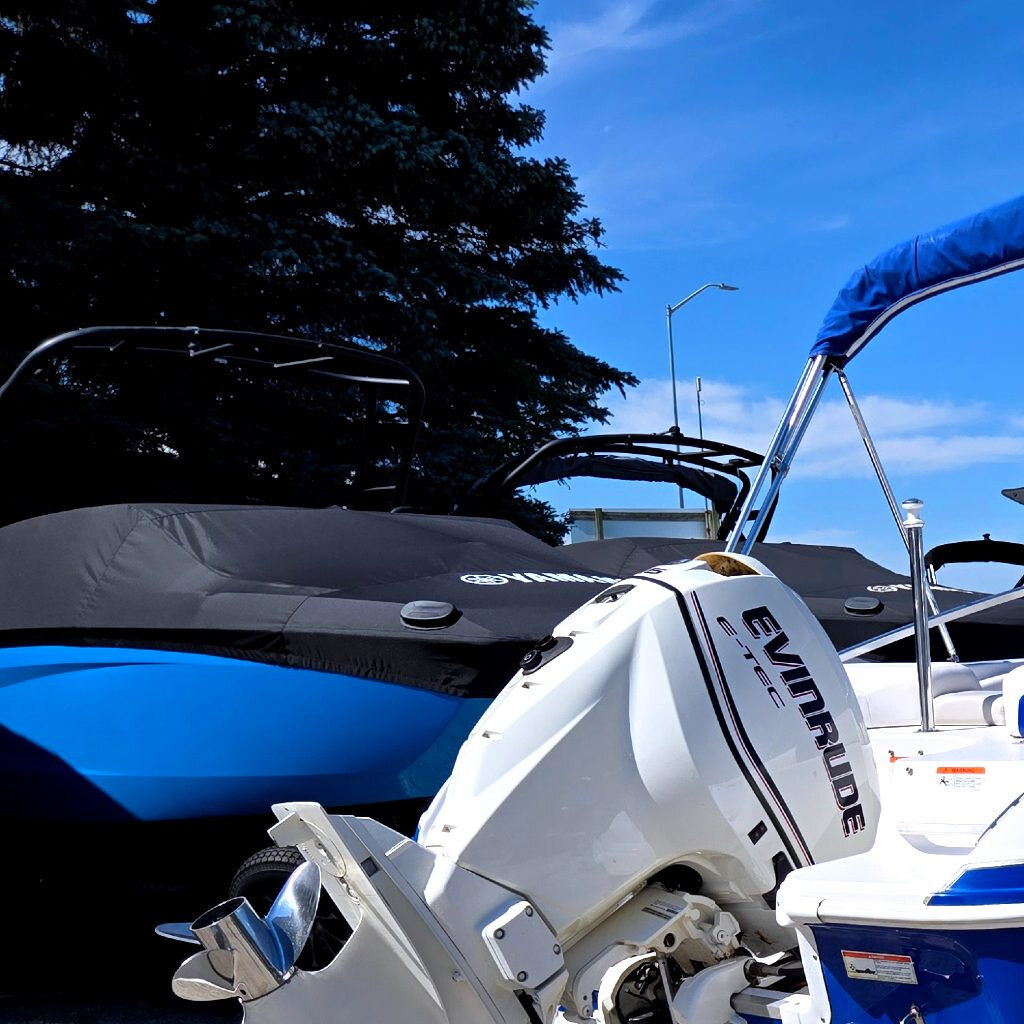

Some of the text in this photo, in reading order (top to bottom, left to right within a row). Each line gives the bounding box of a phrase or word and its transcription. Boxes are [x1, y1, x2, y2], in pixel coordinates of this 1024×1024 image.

[498, 572, 622, 585] YAMAH
[715, 615, 786, 709] E-TEC
[740, 605, 866, 838] EVINRUDE
